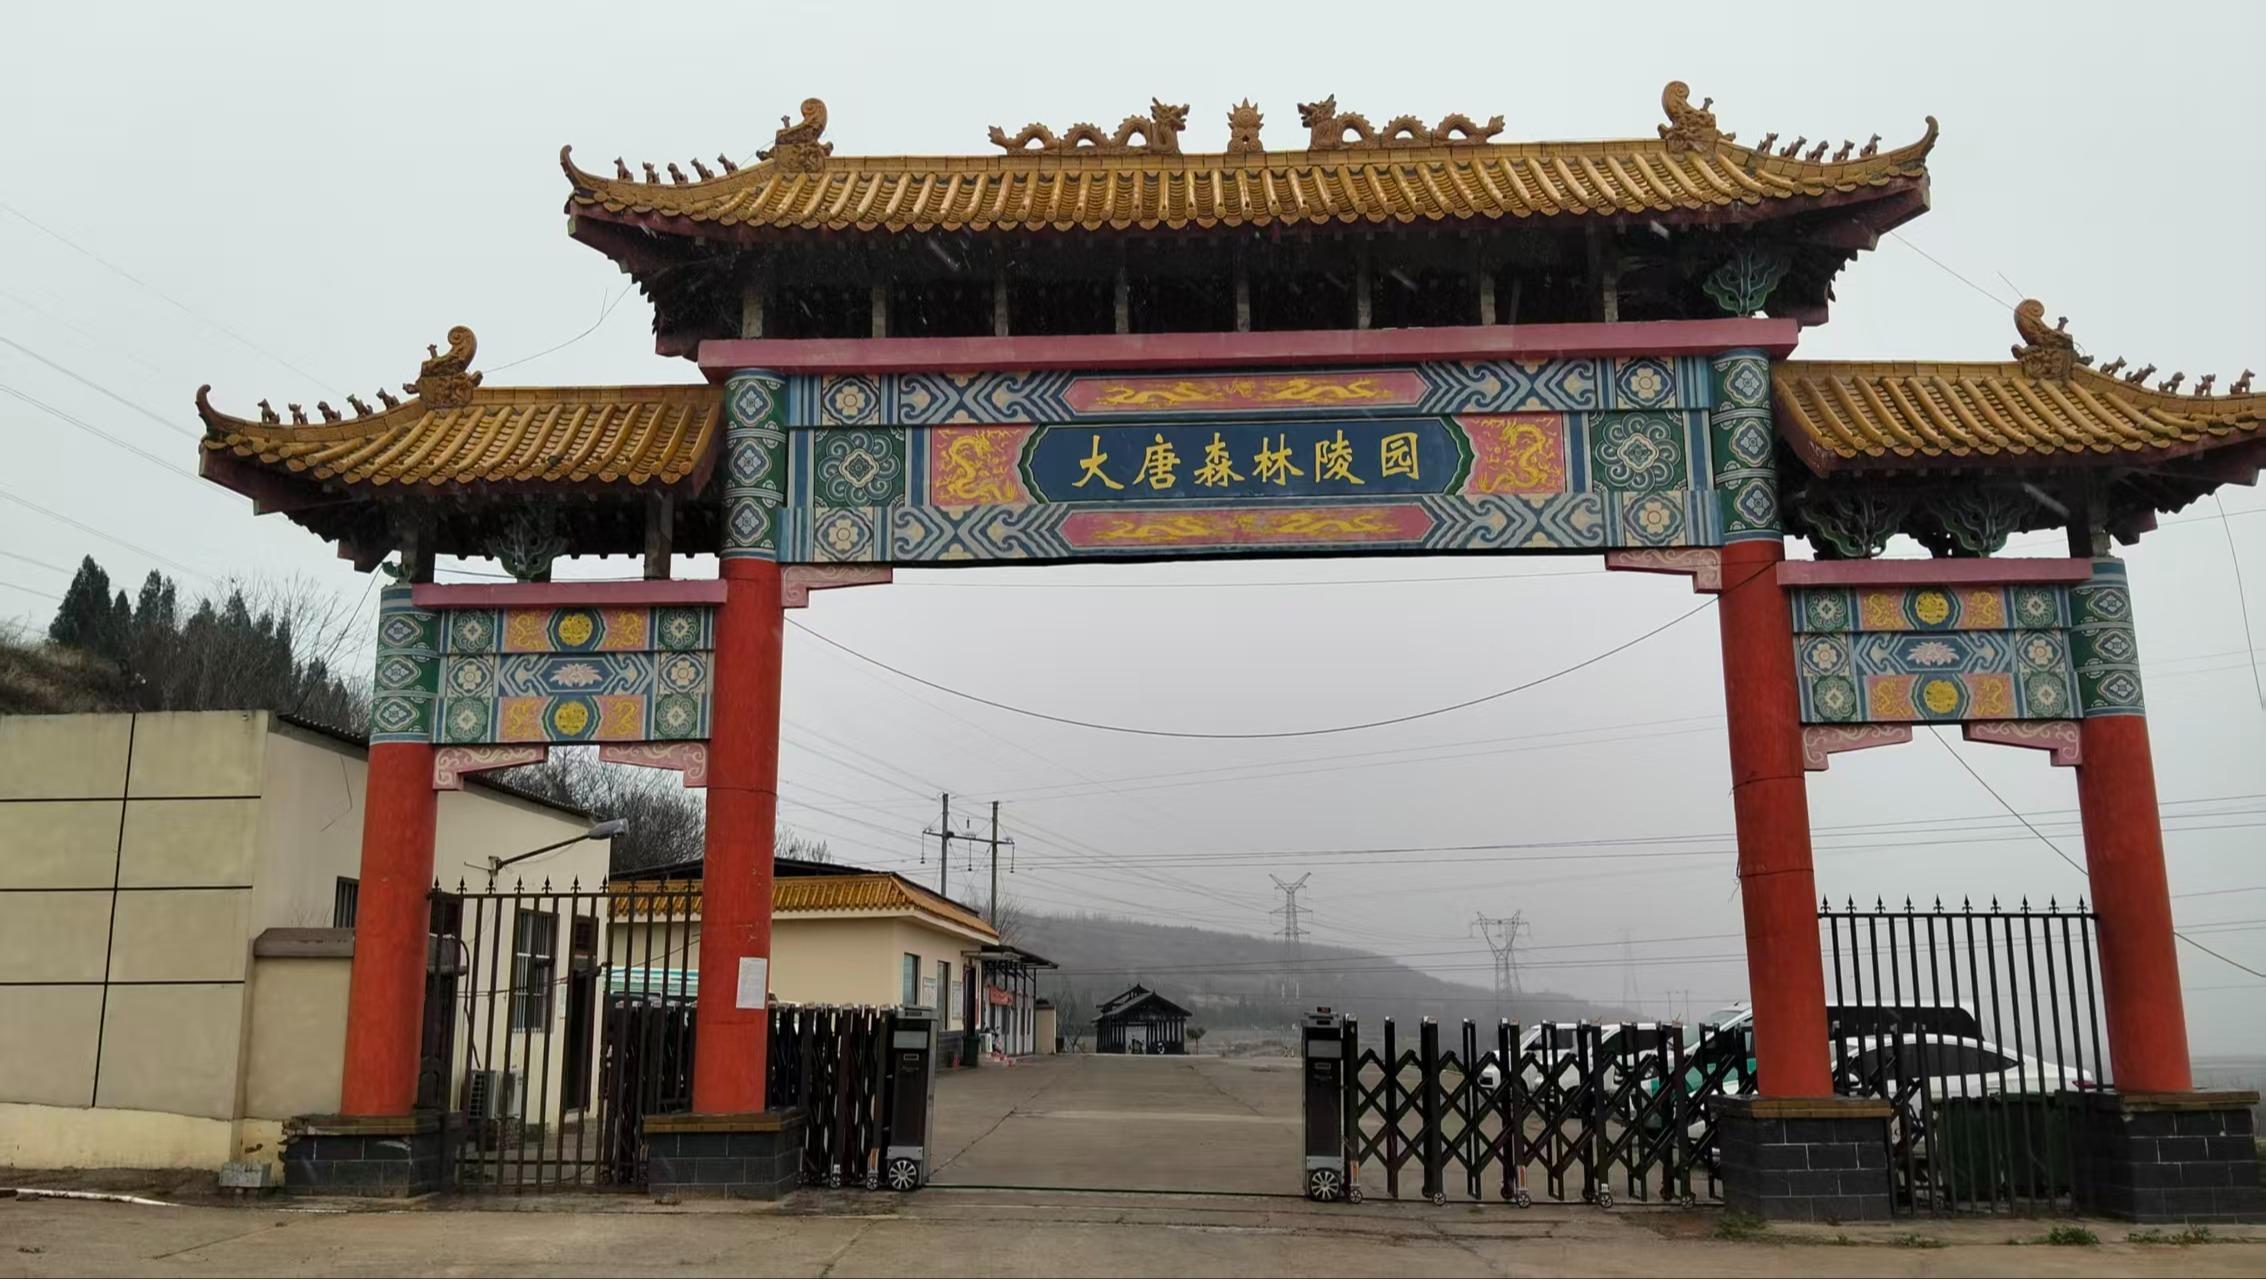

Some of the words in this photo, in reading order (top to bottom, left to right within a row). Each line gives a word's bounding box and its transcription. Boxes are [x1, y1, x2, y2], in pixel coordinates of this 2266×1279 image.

[1072, 429, 1419, 490] 大唐森林陵园
